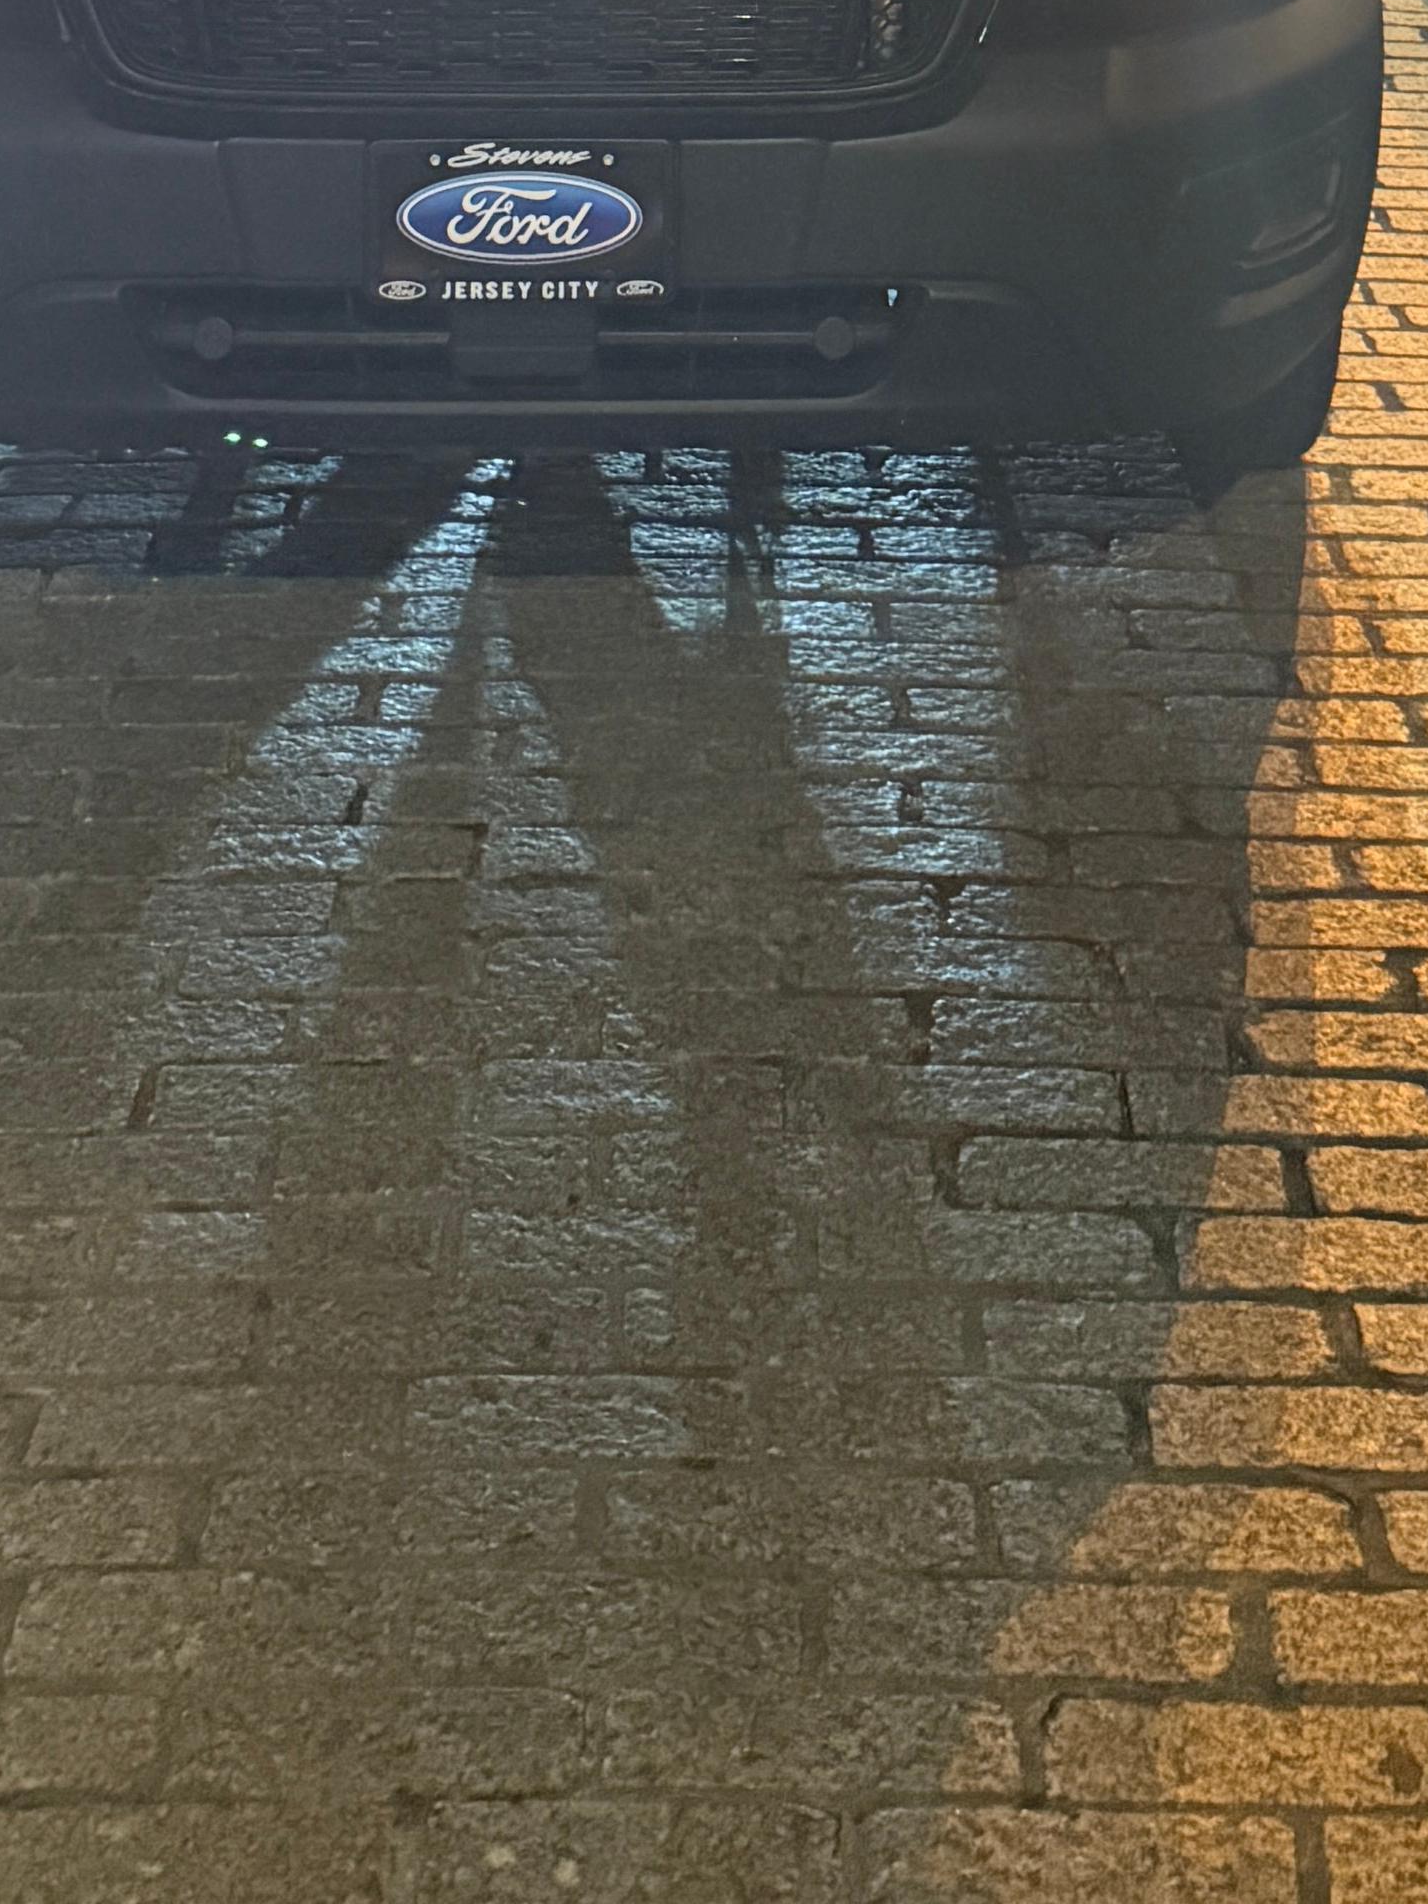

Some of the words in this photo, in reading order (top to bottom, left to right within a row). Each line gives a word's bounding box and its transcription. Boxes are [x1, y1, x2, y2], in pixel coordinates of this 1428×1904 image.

[447, 142, 591, 168] Stevens
[447, 185, 592, 245] Ford
[442, 281, 532, 299] JERSEY
[541, 280, 599, 299] CITY
